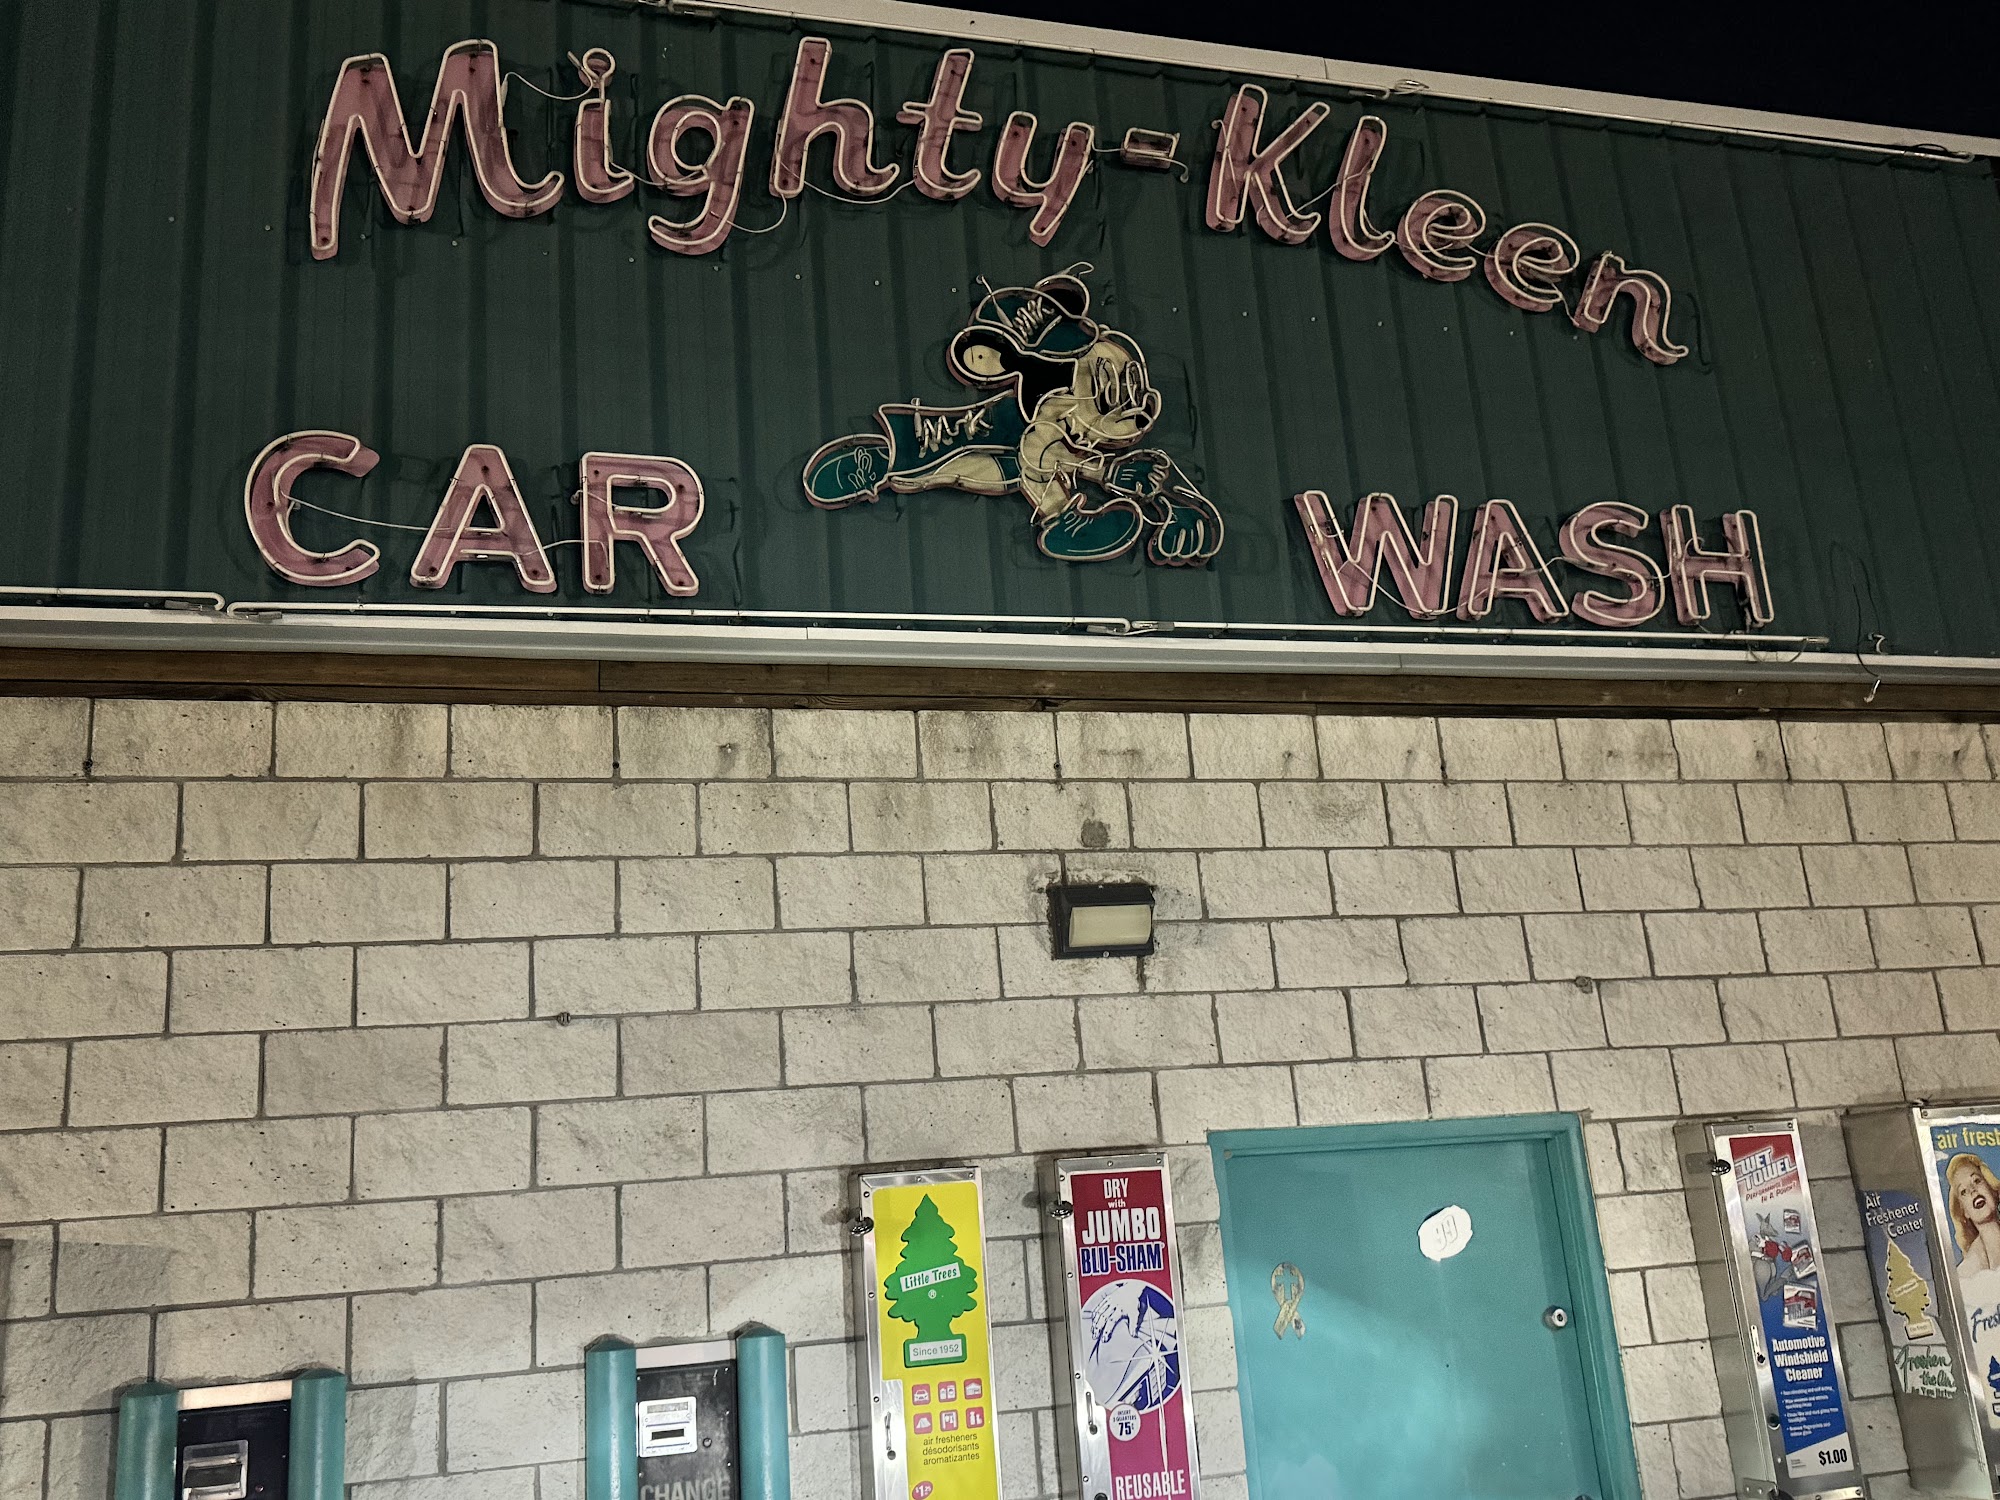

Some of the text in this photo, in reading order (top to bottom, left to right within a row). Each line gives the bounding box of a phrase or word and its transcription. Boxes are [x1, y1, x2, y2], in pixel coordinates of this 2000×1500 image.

[309, 36, 1690, 366] Mighty-Kleen
[243, 429, 704, 597] CAR
[1294, 489, 1775, 627] WASH
[1936, 1129, 1958, 1150] air
[1734, 1147, 1772, 1176] WET
[1736, 1156, 1797, 1191] TOWEL
[1103, 1178, 1128, 1199] DRY
[1108, 1199, 1126, 1208] with
[1864, 1192, 1881, 1210] Air
[1865, 1202, 1918, 1227] Freshener
[1081, 1206, 1161, 1245] JUMBO
[1887, 1218, 1923, 1238] Center
[904, 1268, 957, 1290] Little Trees
[912, 1343, 959, 1357] Since 1952
[1772, 1335, 1826, 1352] Automotive
[1774, 1349, 1829, 1368] Windshield
[1784, 1367, 1823, 1382] Cleaner
[922, 1442, 980, 1456] désodorisants
[923, 1433, 978, 1446] air fresheners
[923, 1452, 980, 1466] aromatizantes
[1818, 1448, 1848, 1467] $1.00
[1115, 1469, 1186, 1500] REUSABLE
